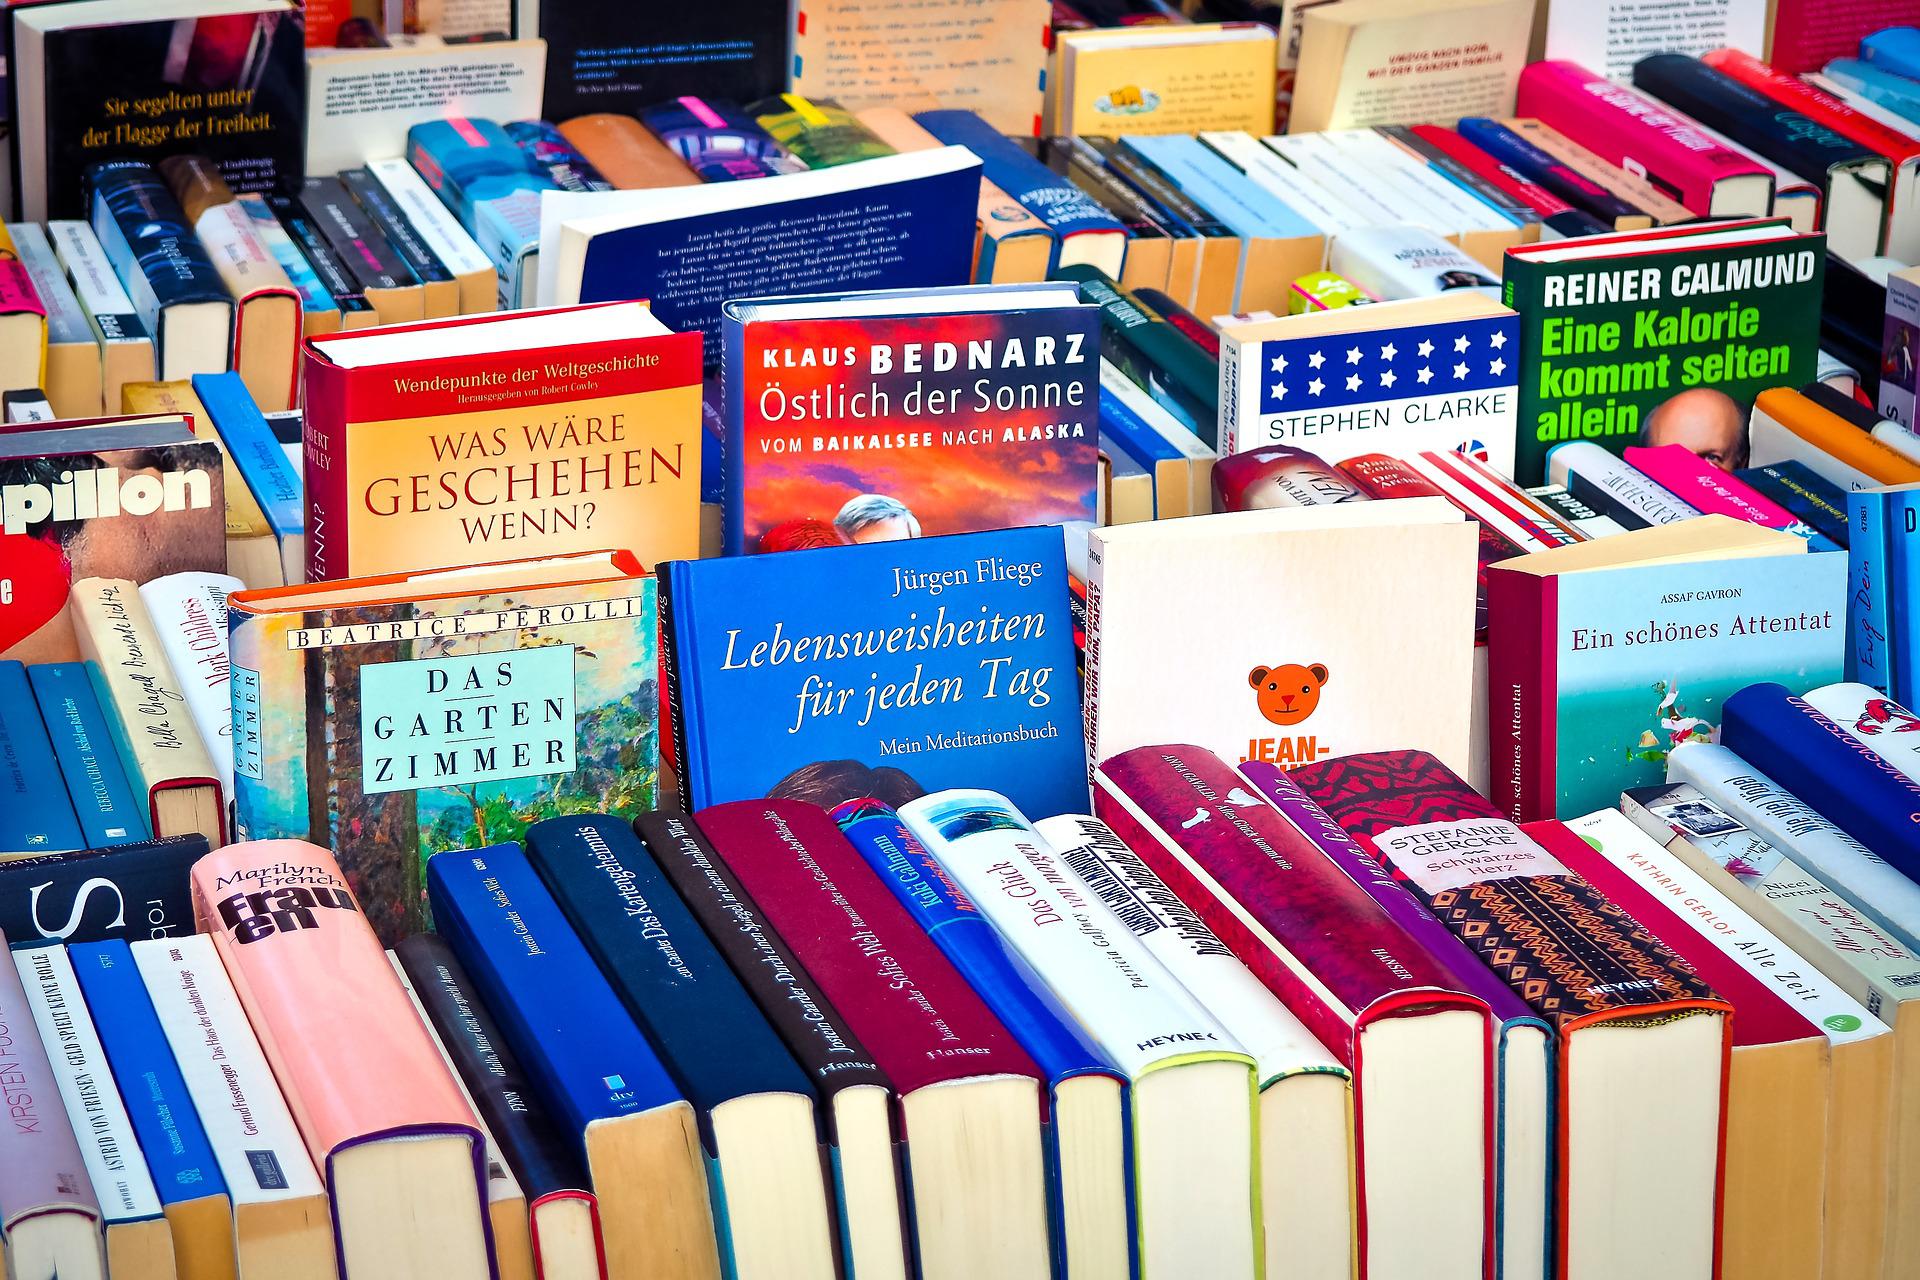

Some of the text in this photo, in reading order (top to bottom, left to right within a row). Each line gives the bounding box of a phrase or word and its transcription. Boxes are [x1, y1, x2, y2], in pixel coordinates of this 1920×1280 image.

[104, 88, 255, 117] Sie segelten unter
[82, 127, 111, 148] der
[116, 123, 170, 147] Flagge
[174, 117, 204, 139] der
[1544, 250, 1816, 308] REINER CALMUND
[1541, 301, 1760, 357] Eine Kalorie
[394, 352, 660, 394] Wendepunkte der Weltgeschichte
[762, 333, 1086, 375] KLAUS BEDNARZ
[1540, 343, 1790, 399] kommt selten
[457, 380, 599, 405] Herausgegeben von Robert Cowley
[760, 378, 1084, 422] Östlich der Sonne
[1229, 360, 1238, 427] happens
[428, 413, 626, 462] WAS WÄRE
[760, 422, 1084, 454] VOM BAIKALSEE NACH ALASKA
[1269, 393, 1506, 440] STEPHEN CLARKE
[1536, 399, 1639, 442] allein
[0, 467, 212, 535] pillon
[364, 443, 684, 517] GESCHEHEN
[460, 502, 597, 545] WENN?
[1557, 490, 1594, 521] PIPER
[892, 556, 1044, 599] Jürgen Fliege
[1660, 588, 1742, 605] ASSAF GAVRON
[296, 599, 636, 648] BEATRICE FEROLLI
[1571, 609, 1833, 652] Ein schönes Attentat
[1854, 560, 1886, 669] Ewig Dein
[180, 597, 231, 689] Mark Childress
[721, 605, 1046, 671] Lebensweisheiten
[99, 586, 184, 750] Bella Chagall Brennende Lichter
[427, 661, 512, 694] DAS
[788, 656, 1054, 734] für jeden Tag
[231, 670, 244, 769] GARTEN
[246, 675, 259, 774] ZIMMER
[374, 697, 566, 741] GARTEN
[879, 722, 1059, 758] Mein Meditationsbuch
[375, 739, 566, 782] ZIMMER
[1239, 736, 1330, 764] JEAN-
[1511, 683, 1522, 799] schönes Attentat
[1162, 754, 1283, 861] ANNA GAVALDA Alles Glück kommt
[1723, 774, 1771, 802] Vögel
[667, 817, 688, 839] Wort
[1274, 777, 1400, 891] Anna Gavalda
[1390, 824, 1515, 851] STEFANIE
[1411, 834, 1517, 857] GERCKE
[679, 835, 712, 867] dunklen
[872, 833, 943, 910] Kuki Gallmann
[1426, 850, 1535, 874] Schwarzes
[1467, 862, 1518, 877] Herz
[216, 862, 325, 892] Marilyn
[258, 872, 344, 890] French
[575, 826, 670, 942] Das Kartengeheimnis
[986, 857, 1064, 928] Das Glück
[1015, 842, 1087, 908] von morgen
[1763, 879, 1811, 892] Nicci
[1766, 885, 1830, 901] Gerrard
[216, 885, 359, 932] Frau
[233, 905, 320, 945] en
[1626, 852, 1821, 1003] KATHRIN GERLOF Alle Zeit
[763, 951, 796, 982] Durch
[852, 925, 914, 991] Sofies Welt
[1073, 913, 1149, 989] Patricia Gaffney
[1370, 947, 1414, 982] HANSER
[787, 983, 824, 1021] Gaarder
[1585, 978, 1654, 996] HEYNE
[809, 1020, 854, 1051] Jostein
[1137, 1031, 1206, 1052] HEYNE
[32, 953, 127, 1172] ASTRID VON FRIESEN GELD SPIELT KEINE ROLLE
[187, 988, 259, 1136] Gertrud Fussenegger Das Haus der dunklen
[818, 1060, 877, 1076] Hanser
[1, 1061, 43, 1136] KIRSTEN
[504, 1092, 527, 1111] FYNN
[117, 1180, 137, 1211] ROWOHLT
